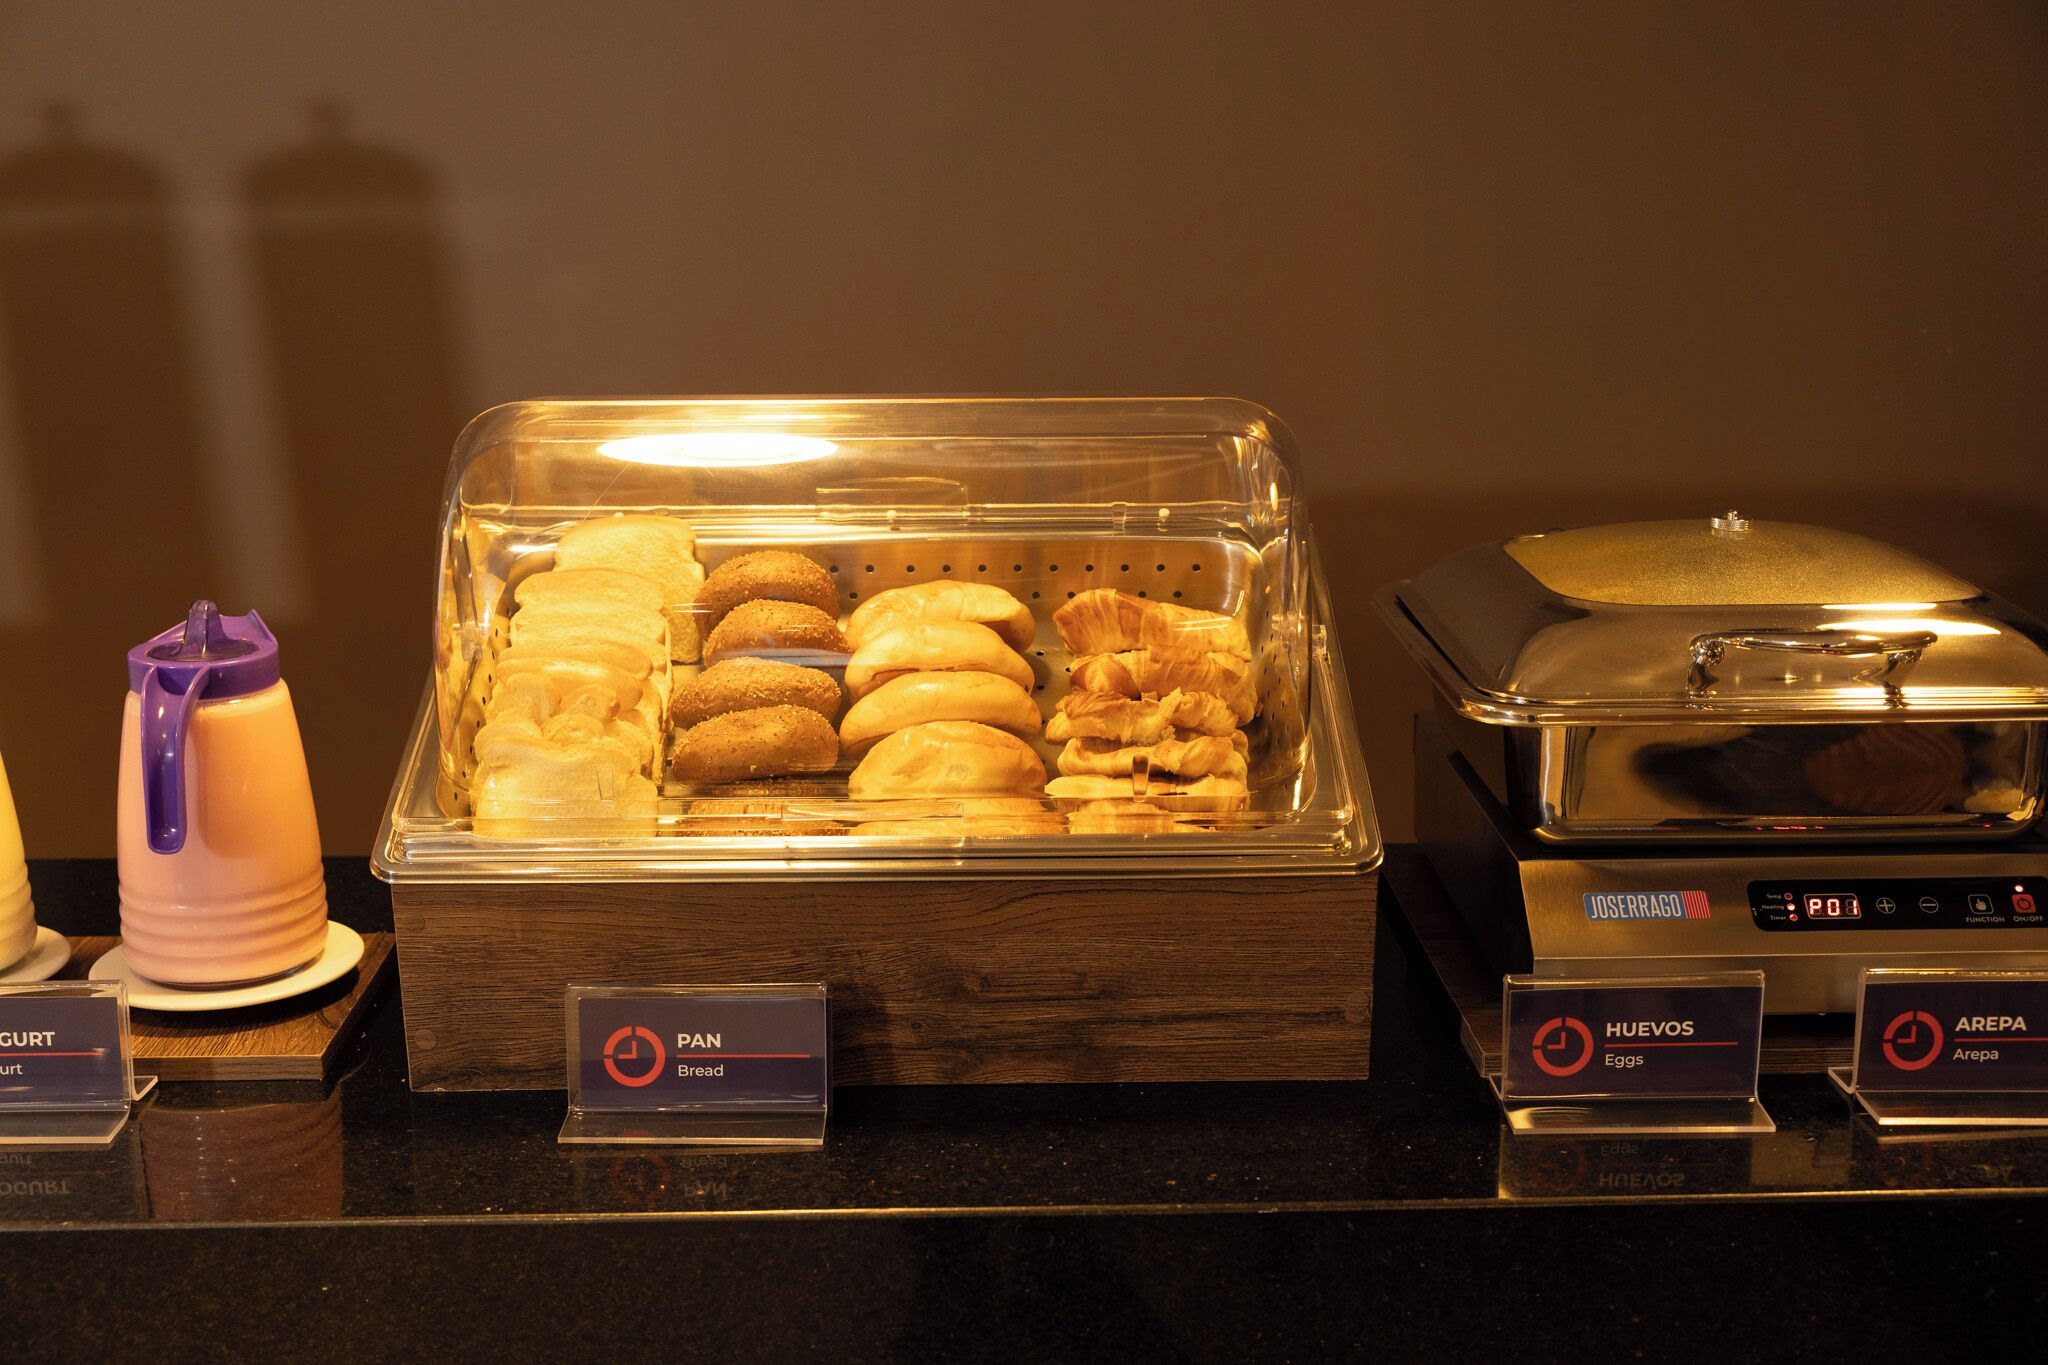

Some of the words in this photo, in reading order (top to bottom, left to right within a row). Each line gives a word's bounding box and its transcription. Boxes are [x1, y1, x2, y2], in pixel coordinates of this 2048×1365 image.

[1590, 894, 1682, 918] JOSERRAGO
[1606, 1021, 1695, 1037] HUEVOS
[1955, 1016, 2027, 1032] AREPA
[0, 1031, 56, 1047] GURT
[677, 1033, 721, 1048] PAN
[1604, 1053, 1644, 1068] Eggs
[1953, 1048, 1999, 1062] Arepa
[677, 1064, 724, 1077] Bread
